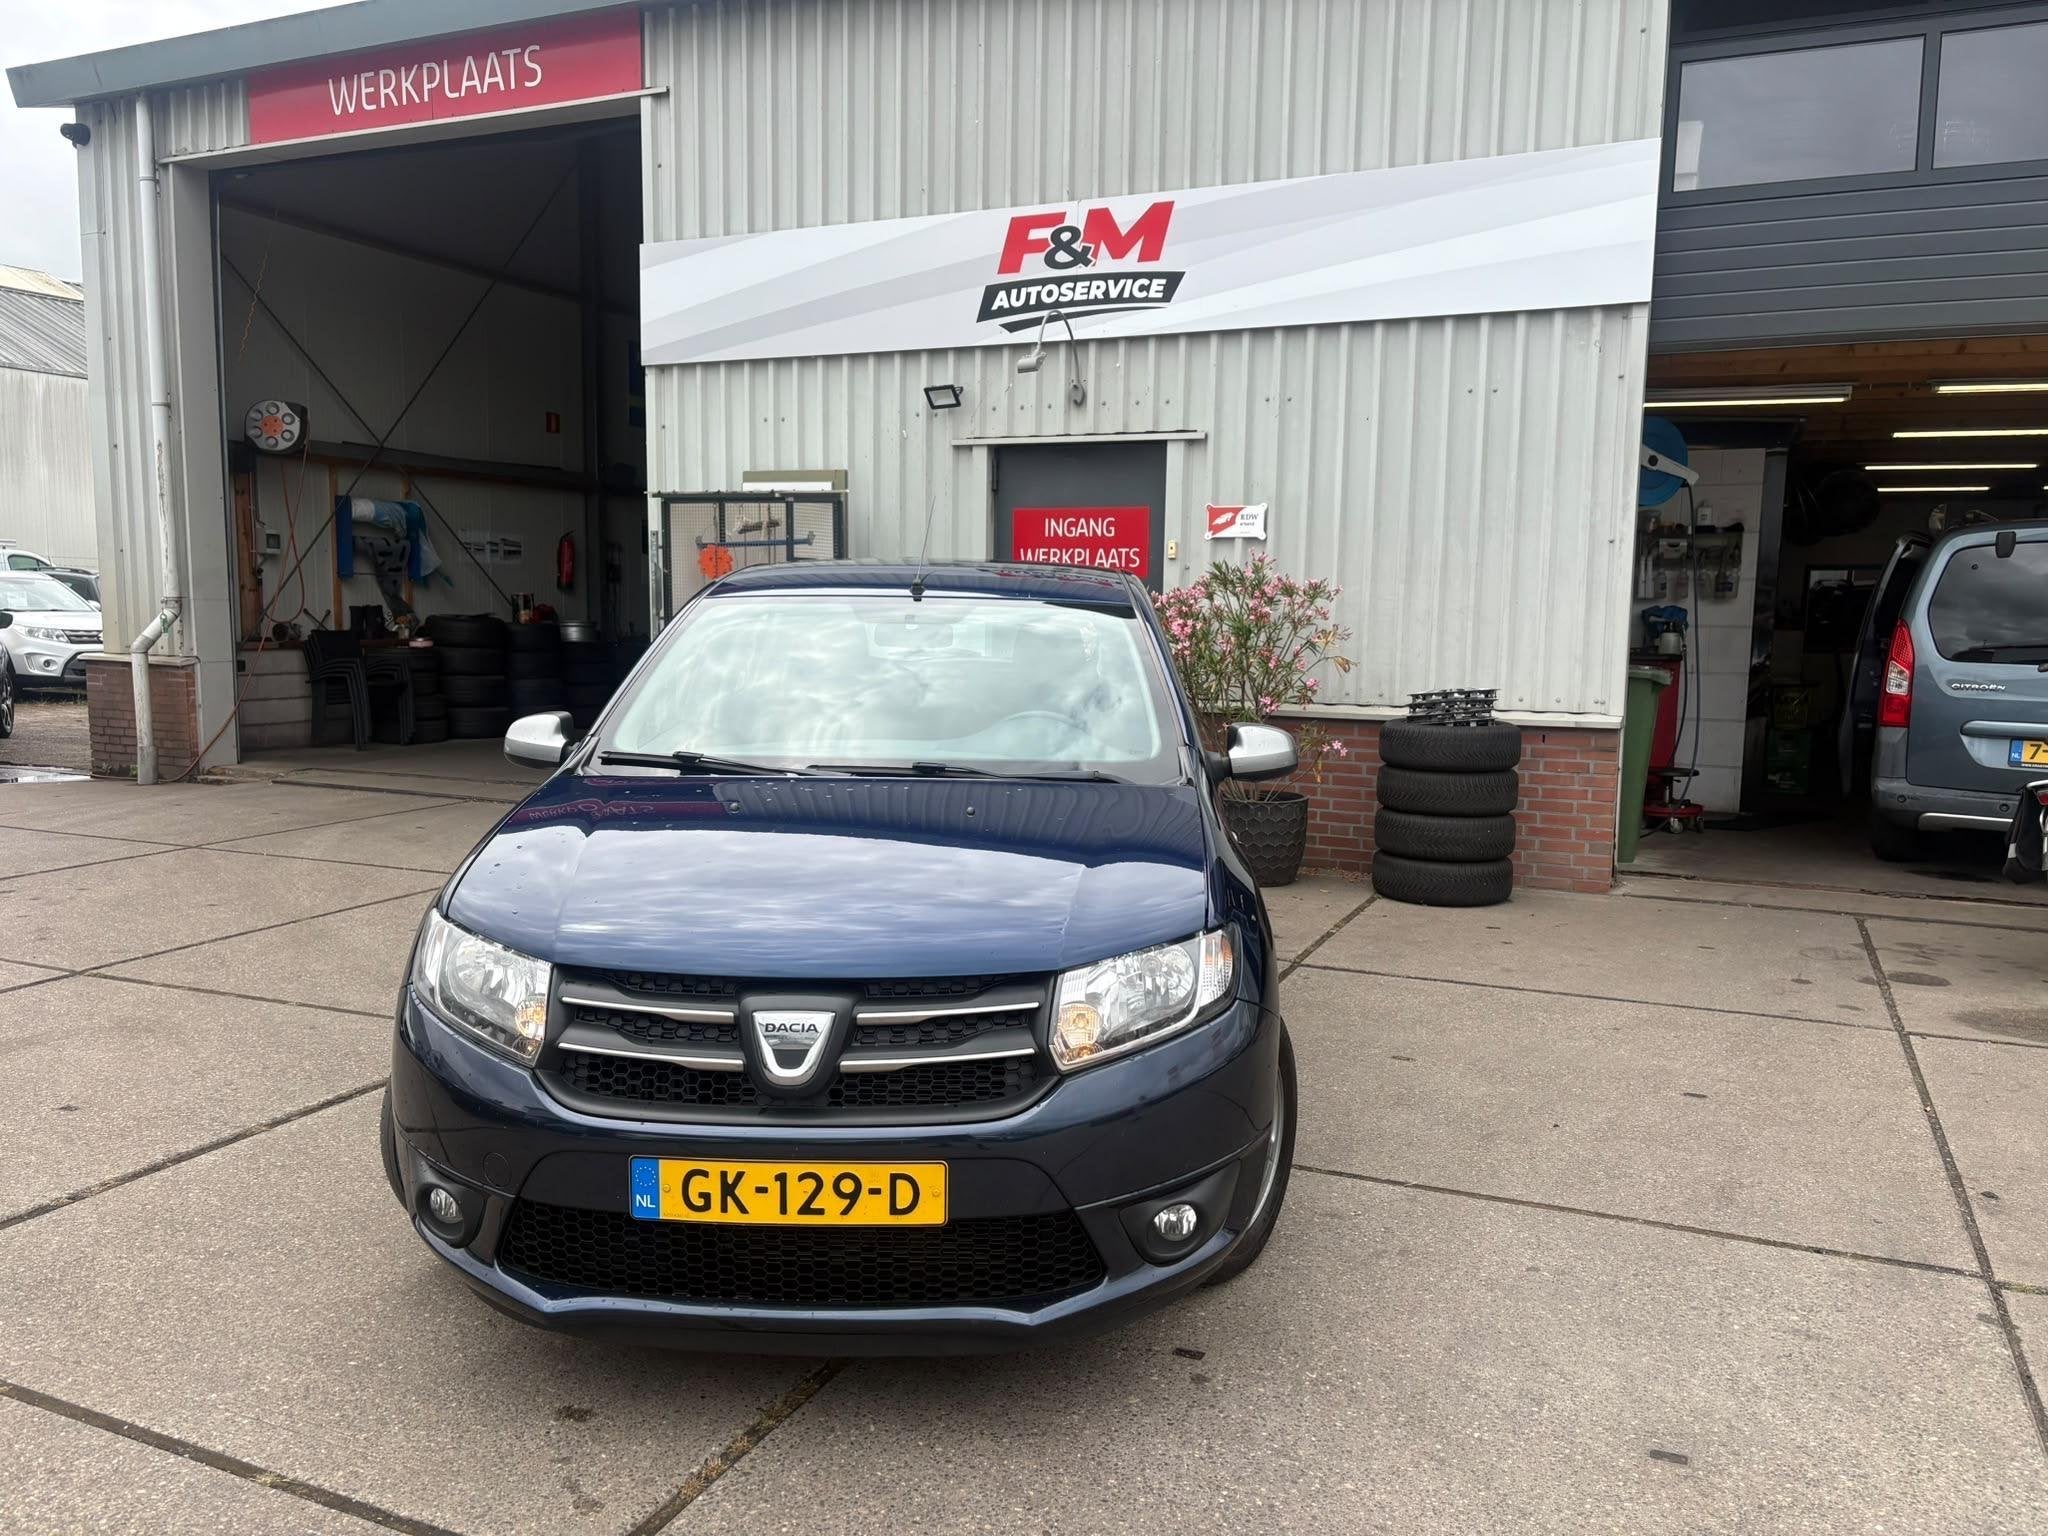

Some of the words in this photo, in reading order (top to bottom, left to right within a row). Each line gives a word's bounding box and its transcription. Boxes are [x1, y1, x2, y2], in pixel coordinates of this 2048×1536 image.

[328, 45, 542, 115] WERKPLAATS
[997, 200, 1175, 275] F&M
[991, 278, 1167, 310] AUTOSERVICE
[1044, 517, 1116, 537] INGANG
[764, 1023, 818, 1033] DACIA
[635, 1194, 656, 1208] NL
[681, 1168, 921, 1216] GK-129-D
